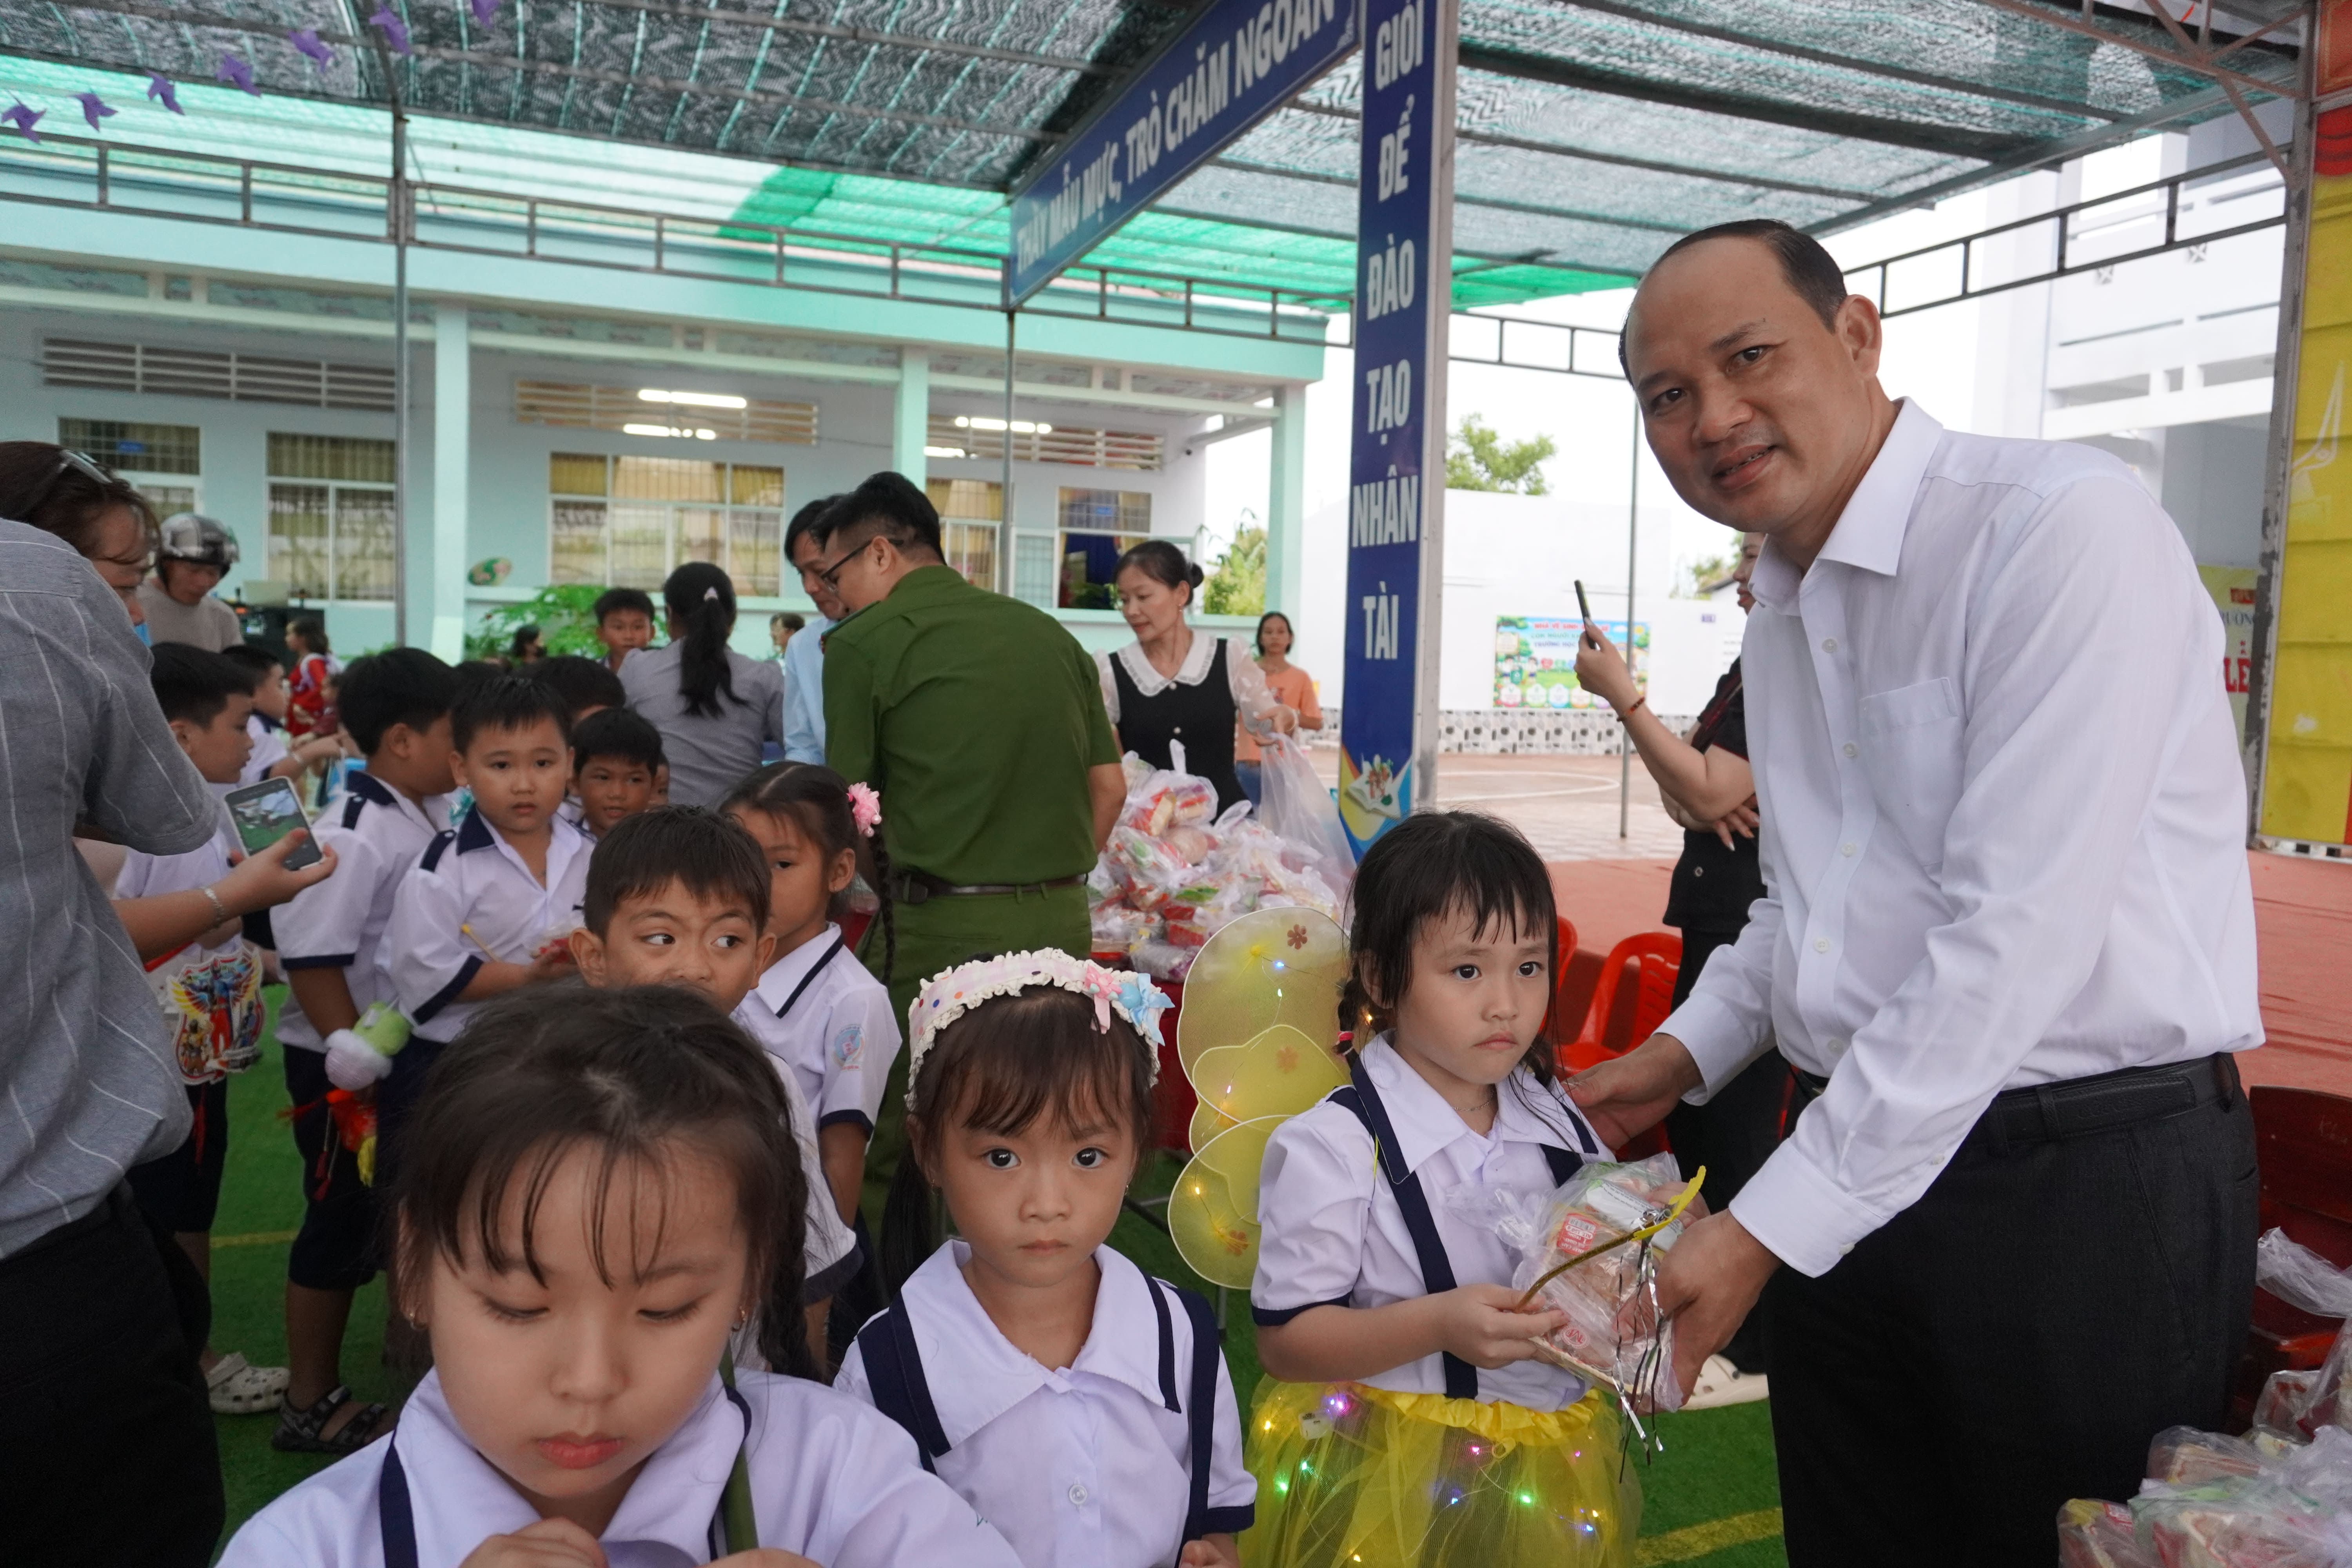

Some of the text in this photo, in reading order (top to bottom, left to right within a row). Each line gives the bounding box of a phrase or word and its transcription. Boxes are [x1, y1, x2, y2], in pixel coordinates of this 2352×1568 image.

[1125, 89, 1161, 185] TRÒ
[1165, 41, 1229, 152] CHĂM
[1377, 94, 1415, 202] ĐỂ
[1367, 233, 1414, 321] ĐÀO
[1366, 359, 1410, 445] TẠO
[1352, 464, 1419, 548] NHÂN
[1362, 581, 1399, 659] TÀI
